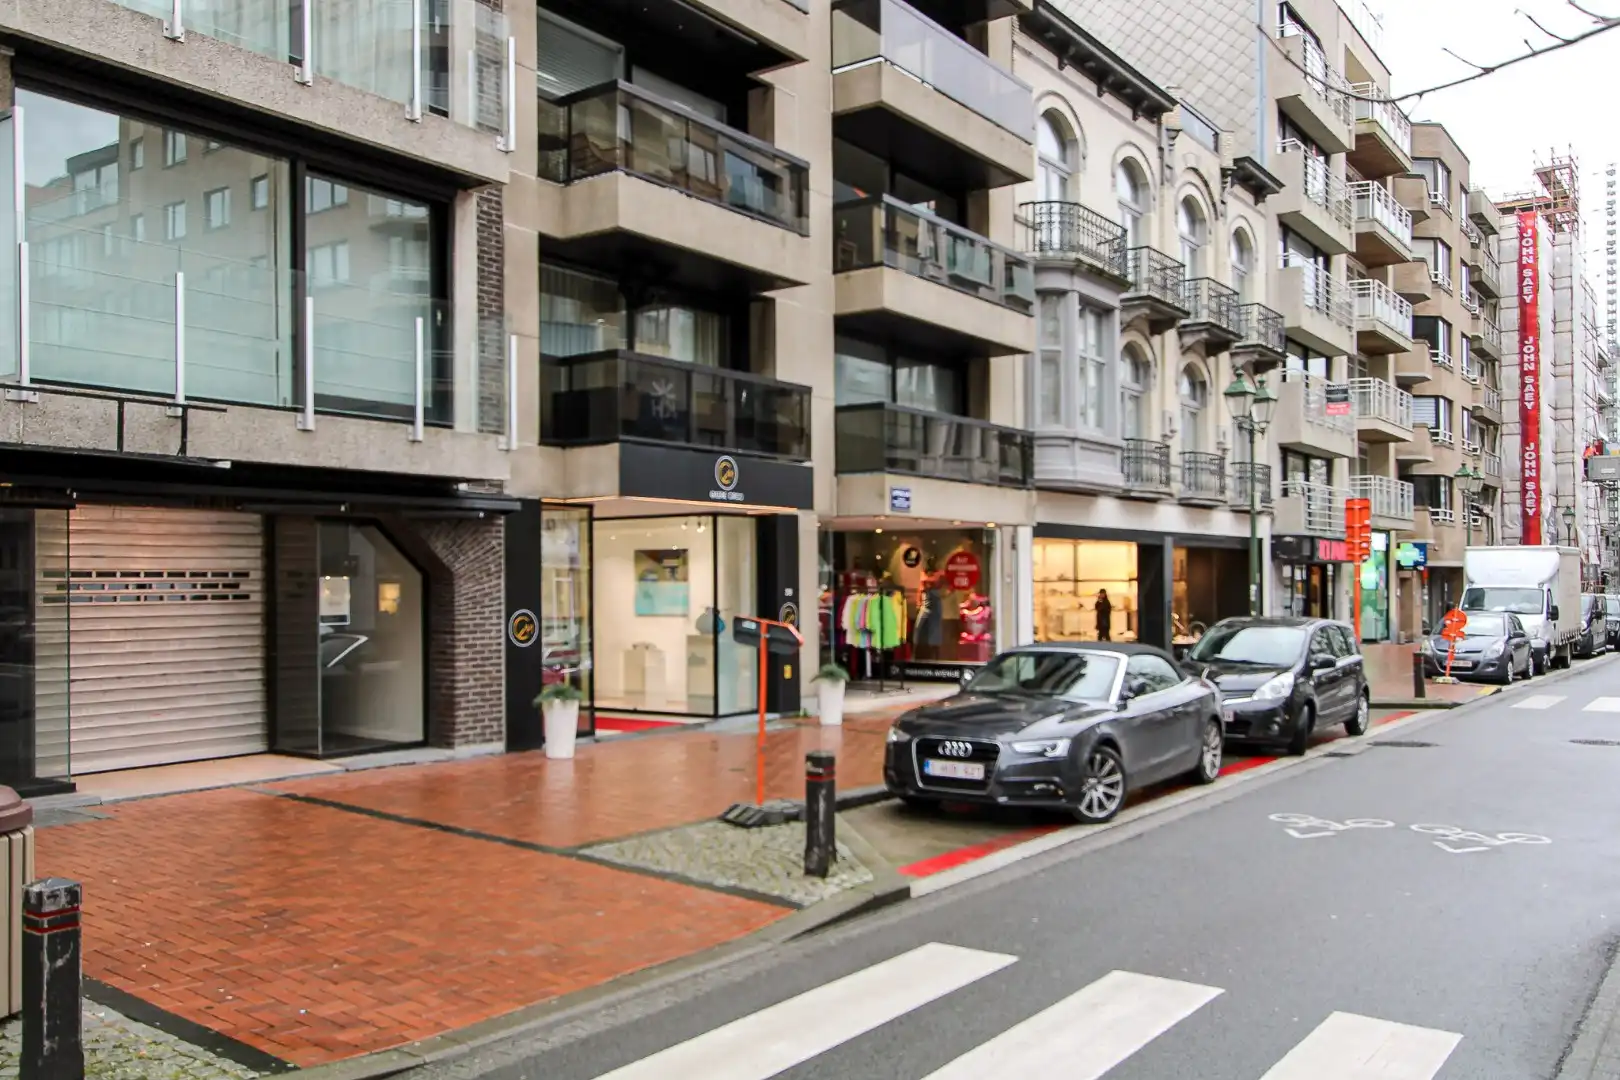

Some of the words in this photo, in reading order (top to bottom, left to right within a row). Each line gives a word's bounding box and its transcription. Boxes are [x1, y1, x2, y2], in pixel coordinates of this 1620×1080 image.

[1521, 228, 1535, 265] JOHN
[1522, 268, 1535, 304] SAEY
[1522, 335, 1536, 371] JOHN
[1523, 375, 1536, 410] SAEY
[1524, 442, 1537, 478] JOHN
[1525, 481, 1537, 516] SAEY
